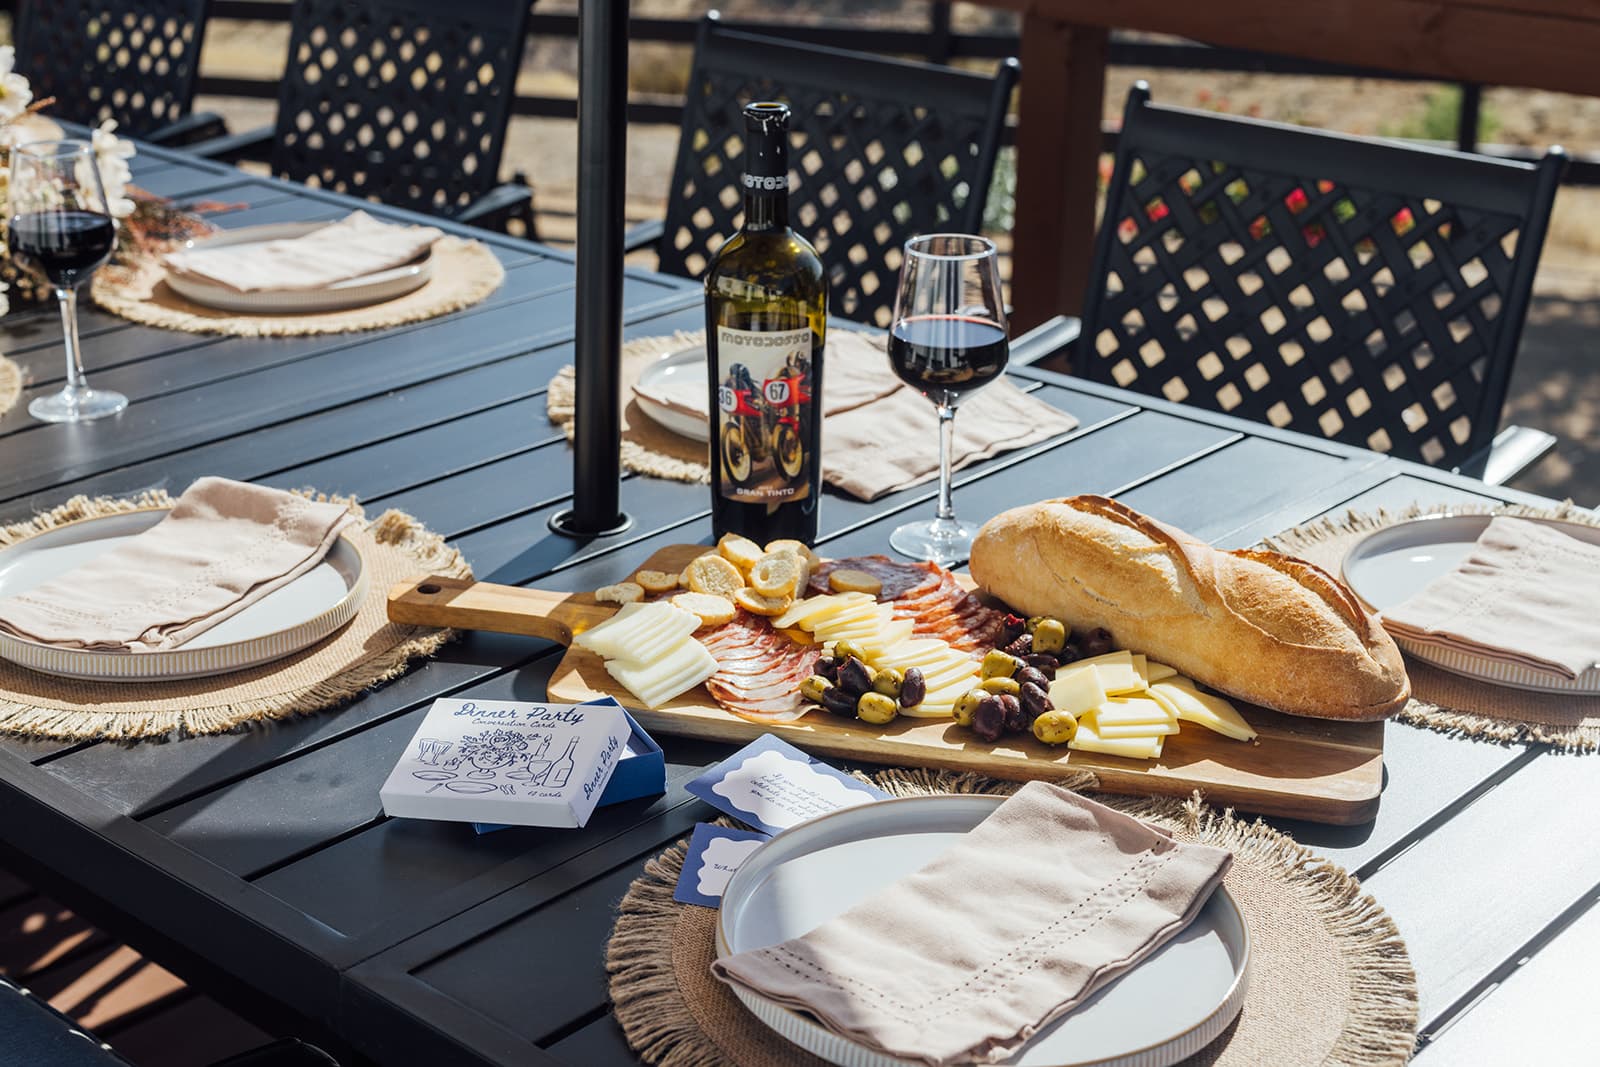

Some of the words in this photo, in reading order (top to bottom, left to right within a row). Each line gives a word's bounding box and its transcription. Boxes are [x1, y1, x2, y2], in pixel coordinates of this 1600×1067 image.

[769, 383, 785, 401] 67
[736, 487, 764, 497] GRAN
[767, 487, 795, 497] TINTO
[453, 702, 519, 719] Dinner
[526, 706, 585, 726] Party
[471, 718, 526, 728] Conversation
[530, 720, 557, 729] Cards
[583, 766, 604, 801] Dinner
[600, 735, 619, 766] Party
